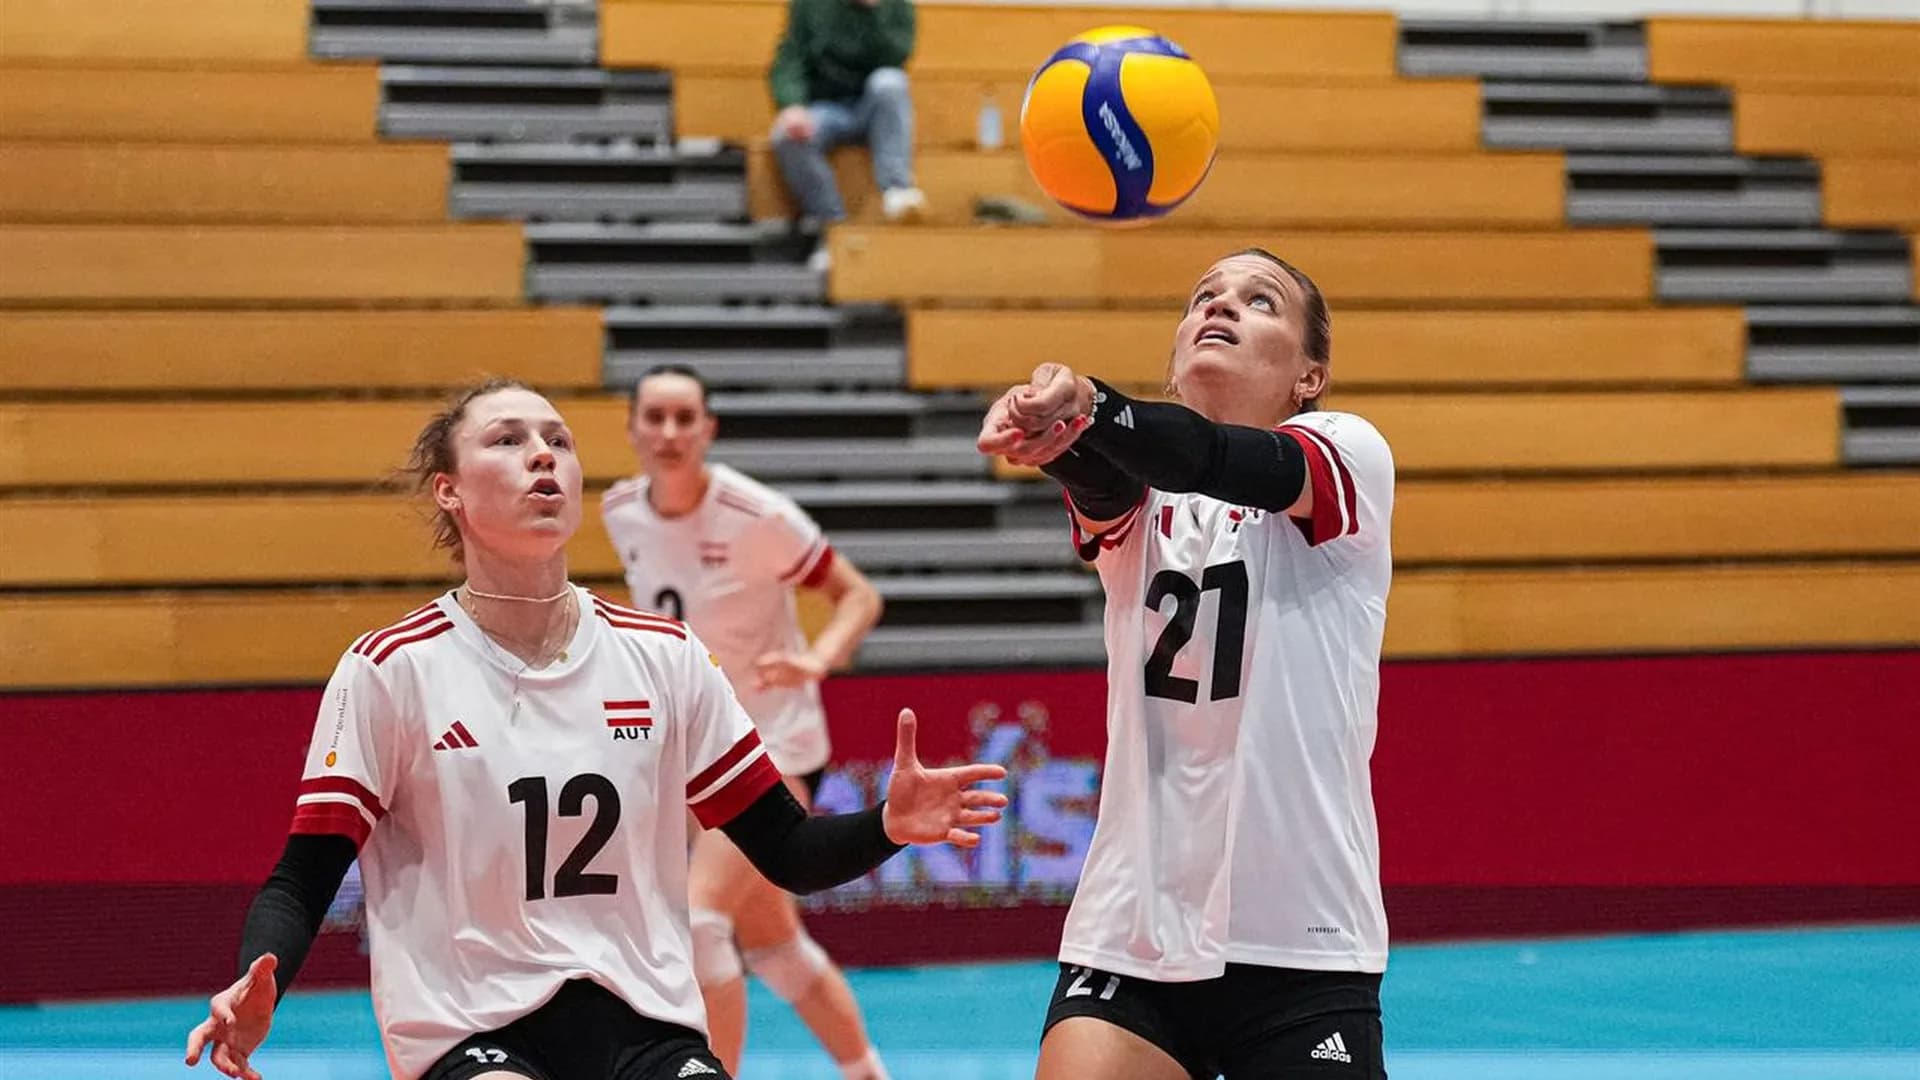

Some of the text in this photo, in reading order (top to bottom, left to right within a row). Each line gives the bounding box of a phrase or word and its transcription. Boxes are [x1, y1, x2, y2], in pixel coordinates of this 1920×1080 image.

[1098, 101, 1142, 171] MIKASA
[1144, 560, 1248, 704] 21
[613, 727, 651, 741] AUT
[507, 774, 621, 902] 12
[1310, 1047, 1352, 1064] adidas
